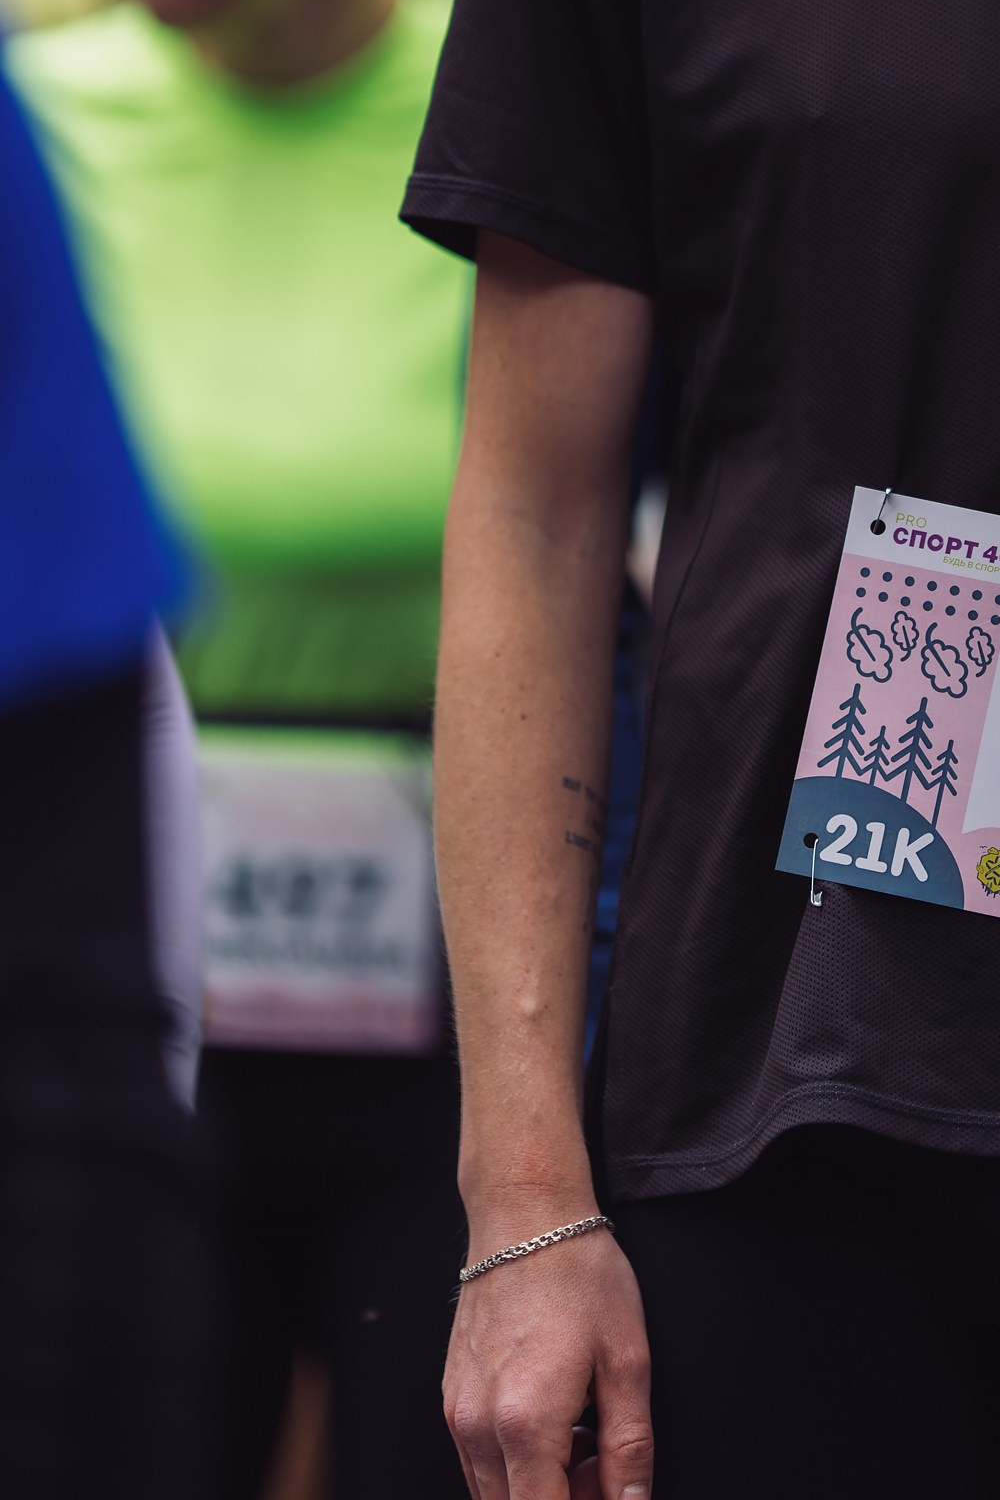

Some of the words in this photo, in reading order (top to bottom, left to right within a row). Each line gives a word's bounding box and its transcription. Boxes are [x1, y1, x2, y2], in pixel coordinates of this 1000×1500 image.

[895, 512, 928, 529] PRO
[893, 527, 980, 559] СПОРТ
[942, 556, 966, 567] БУДЬ
[967, 561, 974, 569] В
